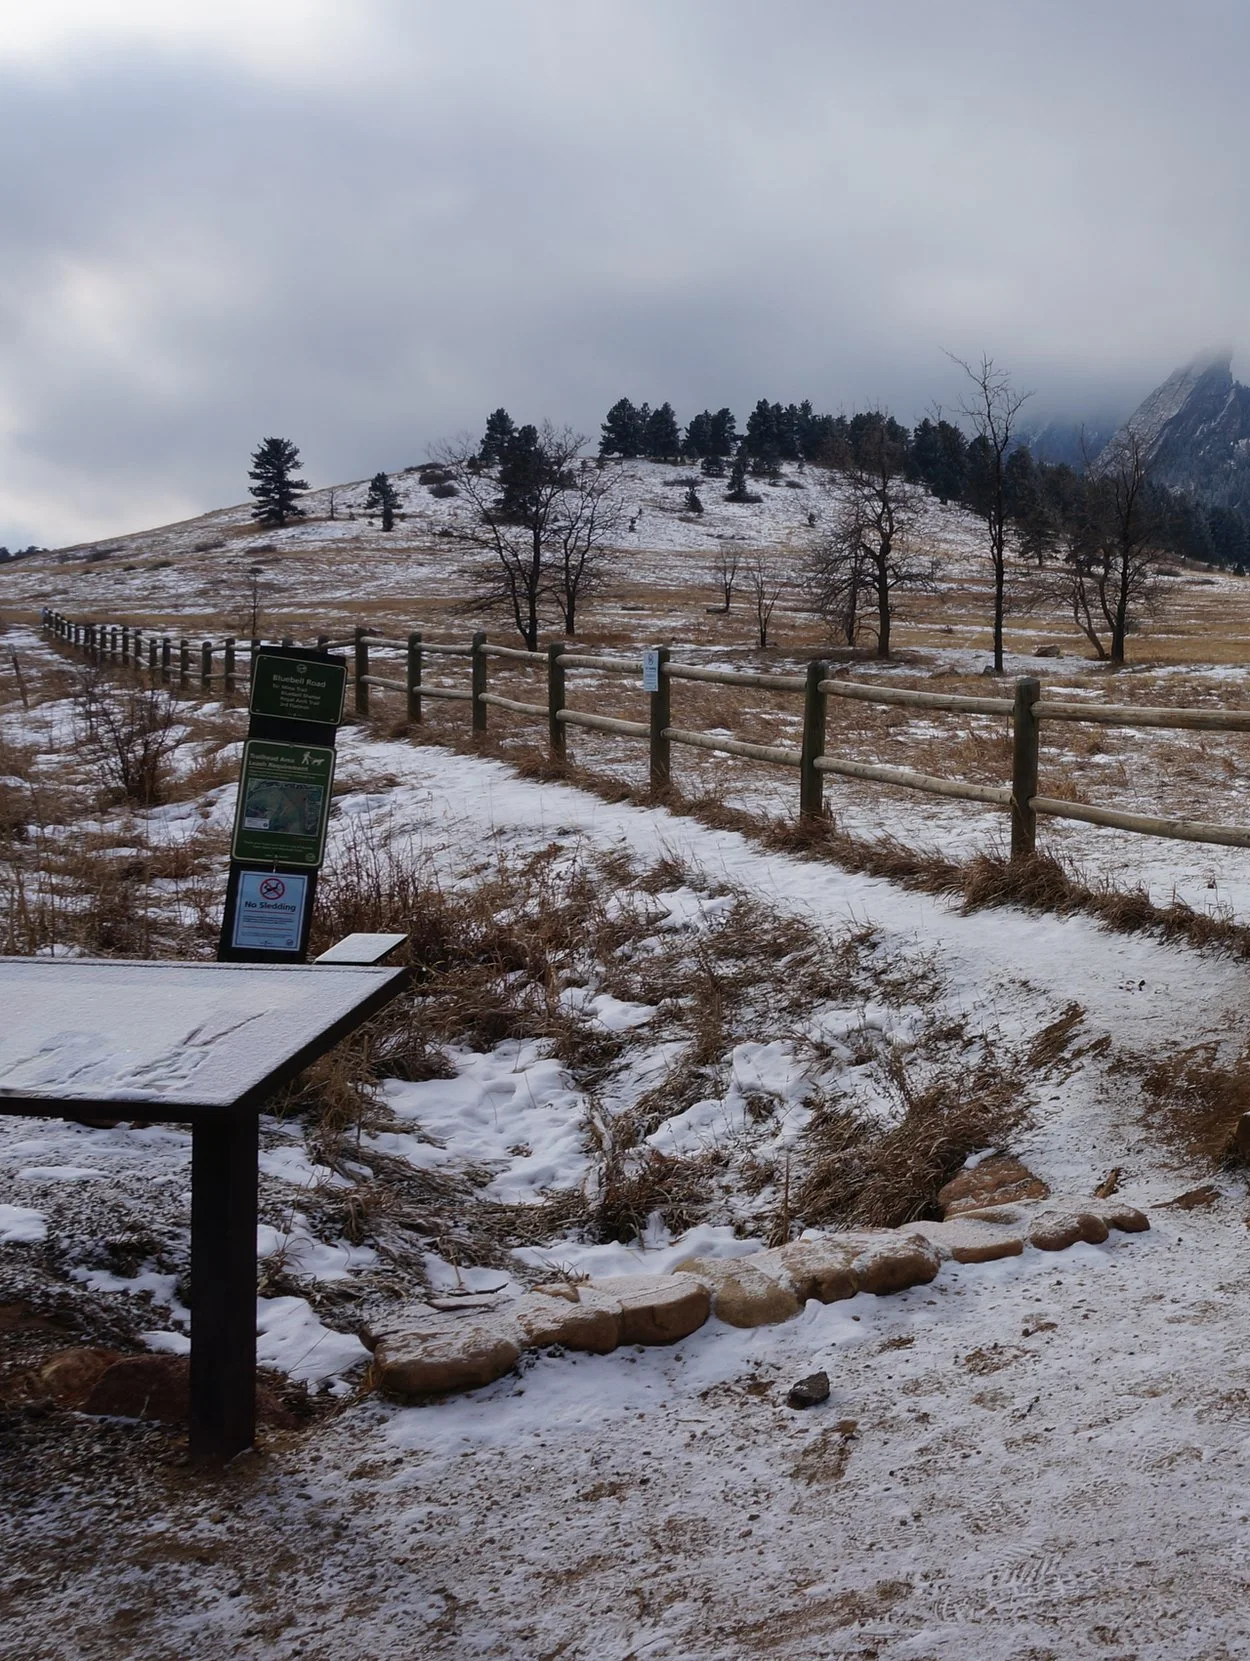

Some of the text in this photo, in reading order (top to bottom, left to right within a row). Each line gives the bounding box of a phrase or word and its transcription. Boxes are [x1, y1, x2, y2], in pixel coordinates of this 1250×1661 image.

[273, 674, 326, 688] Bluebell Road
[250, 752, 279, 762] Trailhead
[248, 760, 267, 768] Leash
[244, 901, 297, 912] No Sledding
